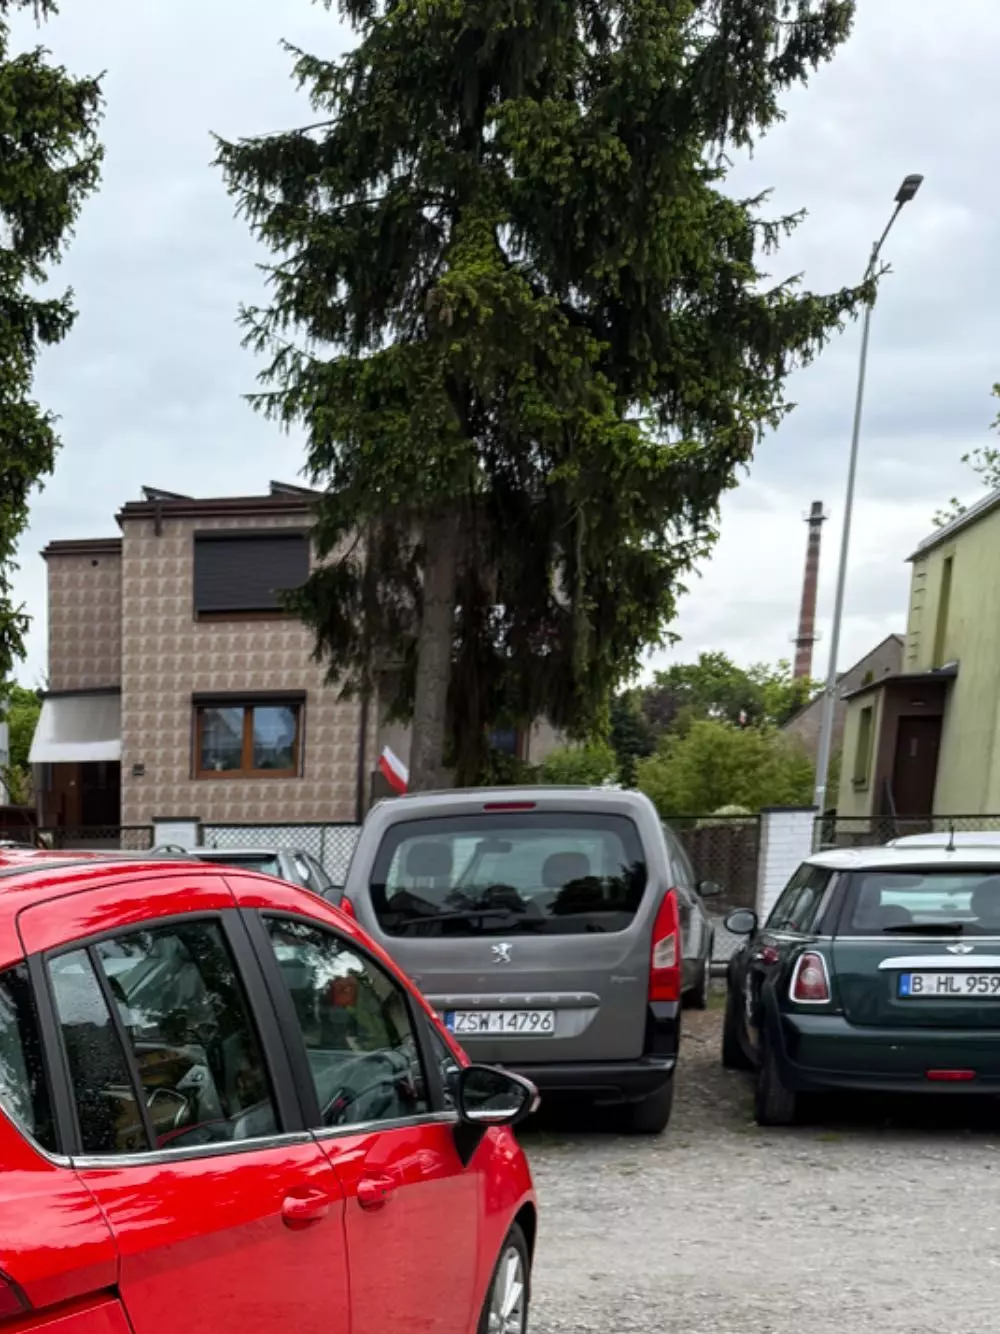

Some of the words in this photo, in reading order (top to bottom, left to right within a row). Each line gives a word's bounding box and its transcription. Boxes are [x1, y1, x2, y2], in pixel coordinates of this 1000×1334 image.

[911, 975, 924, 993] B
[936, 975, 961, 993] HL
[455, 1012, 491, 1032] ZSW
[499, 1012, 552, 1031] 14796
